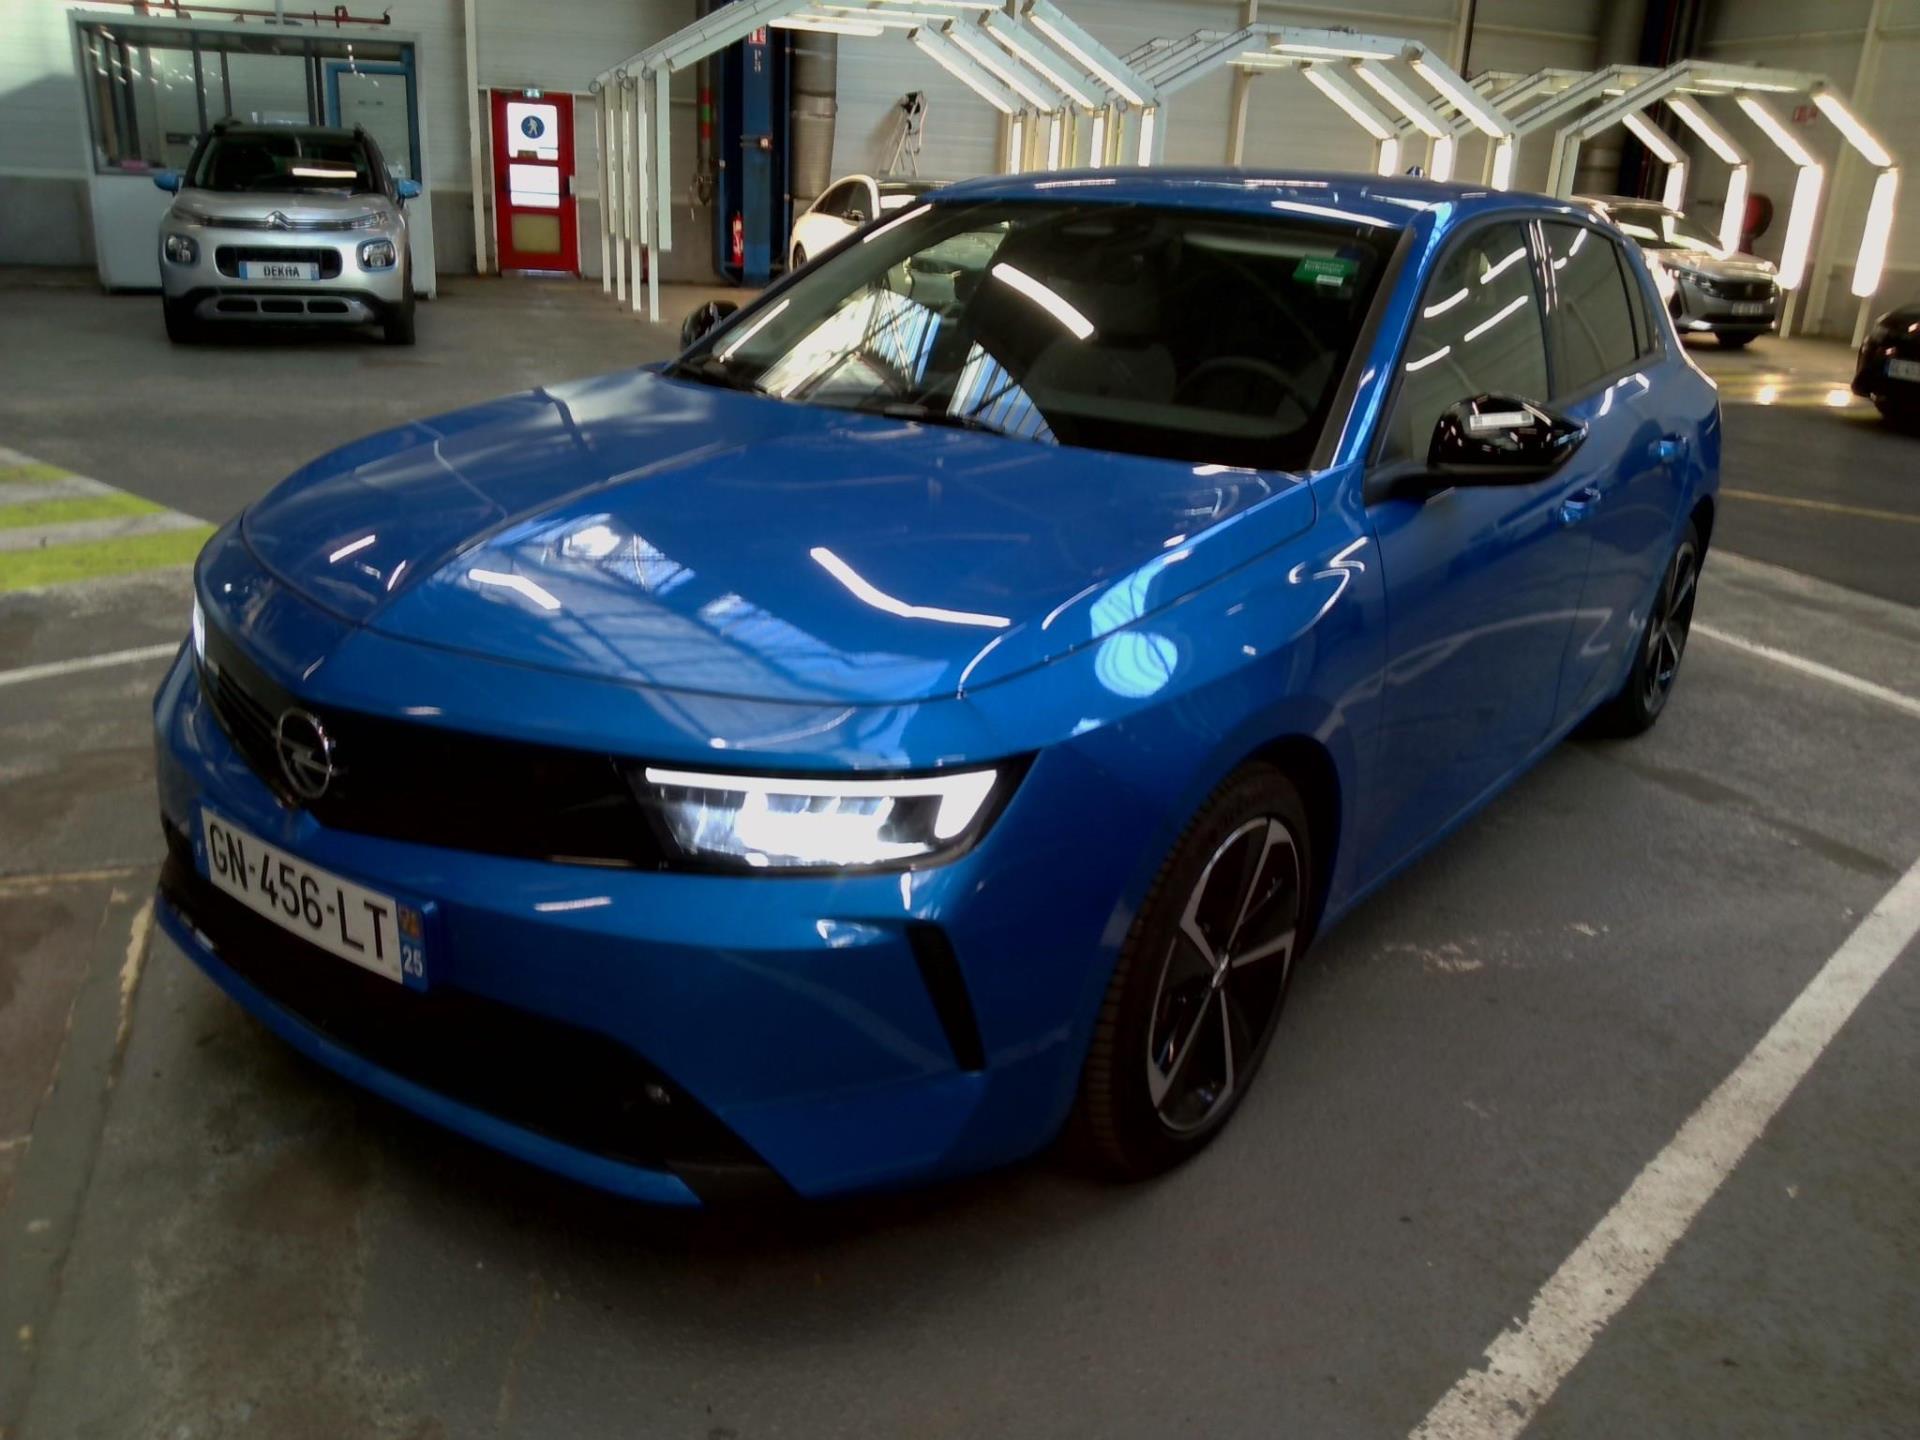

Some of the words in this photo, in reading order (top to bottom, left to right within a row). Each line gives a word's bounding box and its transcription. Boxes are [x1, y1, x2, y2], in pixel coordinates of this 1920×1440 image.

[263, 265, 300, 277] DEKRA
[209, 823, 388, 960] GN-456-LT
[402, 945, 423, 977] 25
